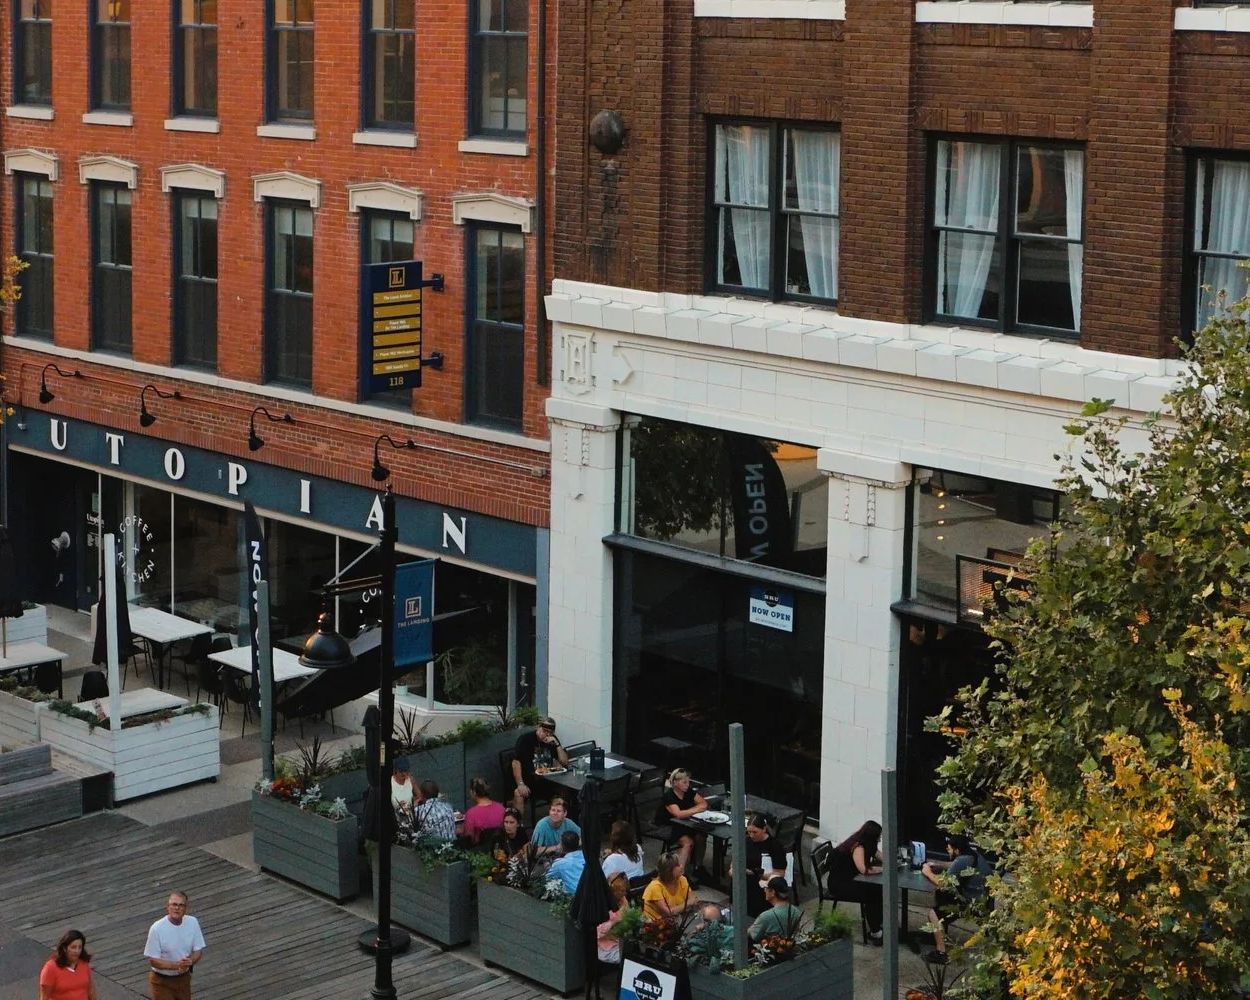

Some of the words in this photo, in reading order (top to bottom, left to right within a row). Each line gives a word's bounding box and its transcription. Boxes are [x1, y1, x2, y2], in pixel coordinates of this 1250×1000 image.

[389, 376, 404, 387] 118
[50, 419, 467, 555] UTOPIAN
[119, 515, 153, 542] COFFEE
[117, 551, 155, 583] KITCHEN
[752, 606, 769, 617] NOW
[770, 611, 791, 621] OPEN
[634, 979, 662, 995] BRU
